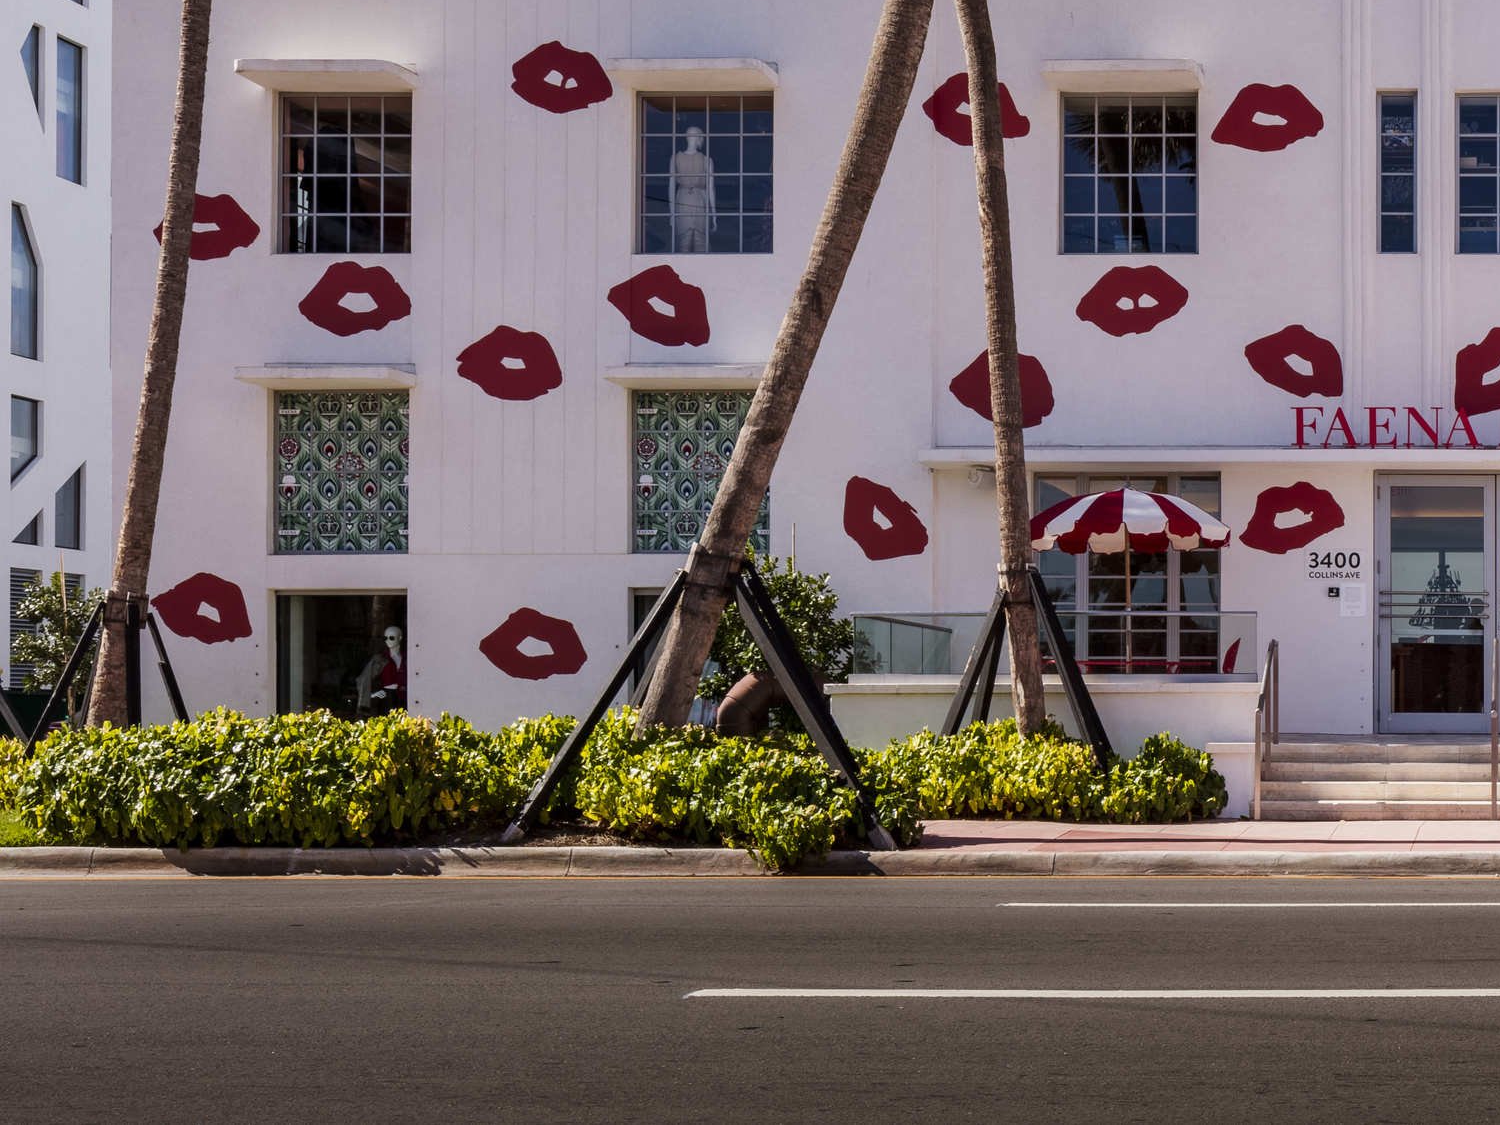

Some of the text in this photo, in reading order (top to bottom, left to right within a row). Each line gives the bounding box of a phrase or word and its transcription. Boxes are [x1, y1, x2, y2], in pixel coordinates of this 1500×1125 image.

[1290, 406, 1483, 448] FAENA
[1308, 552, 1361, 569] 3400
[1308, 571, 1361, 579] COLLINS AVE
